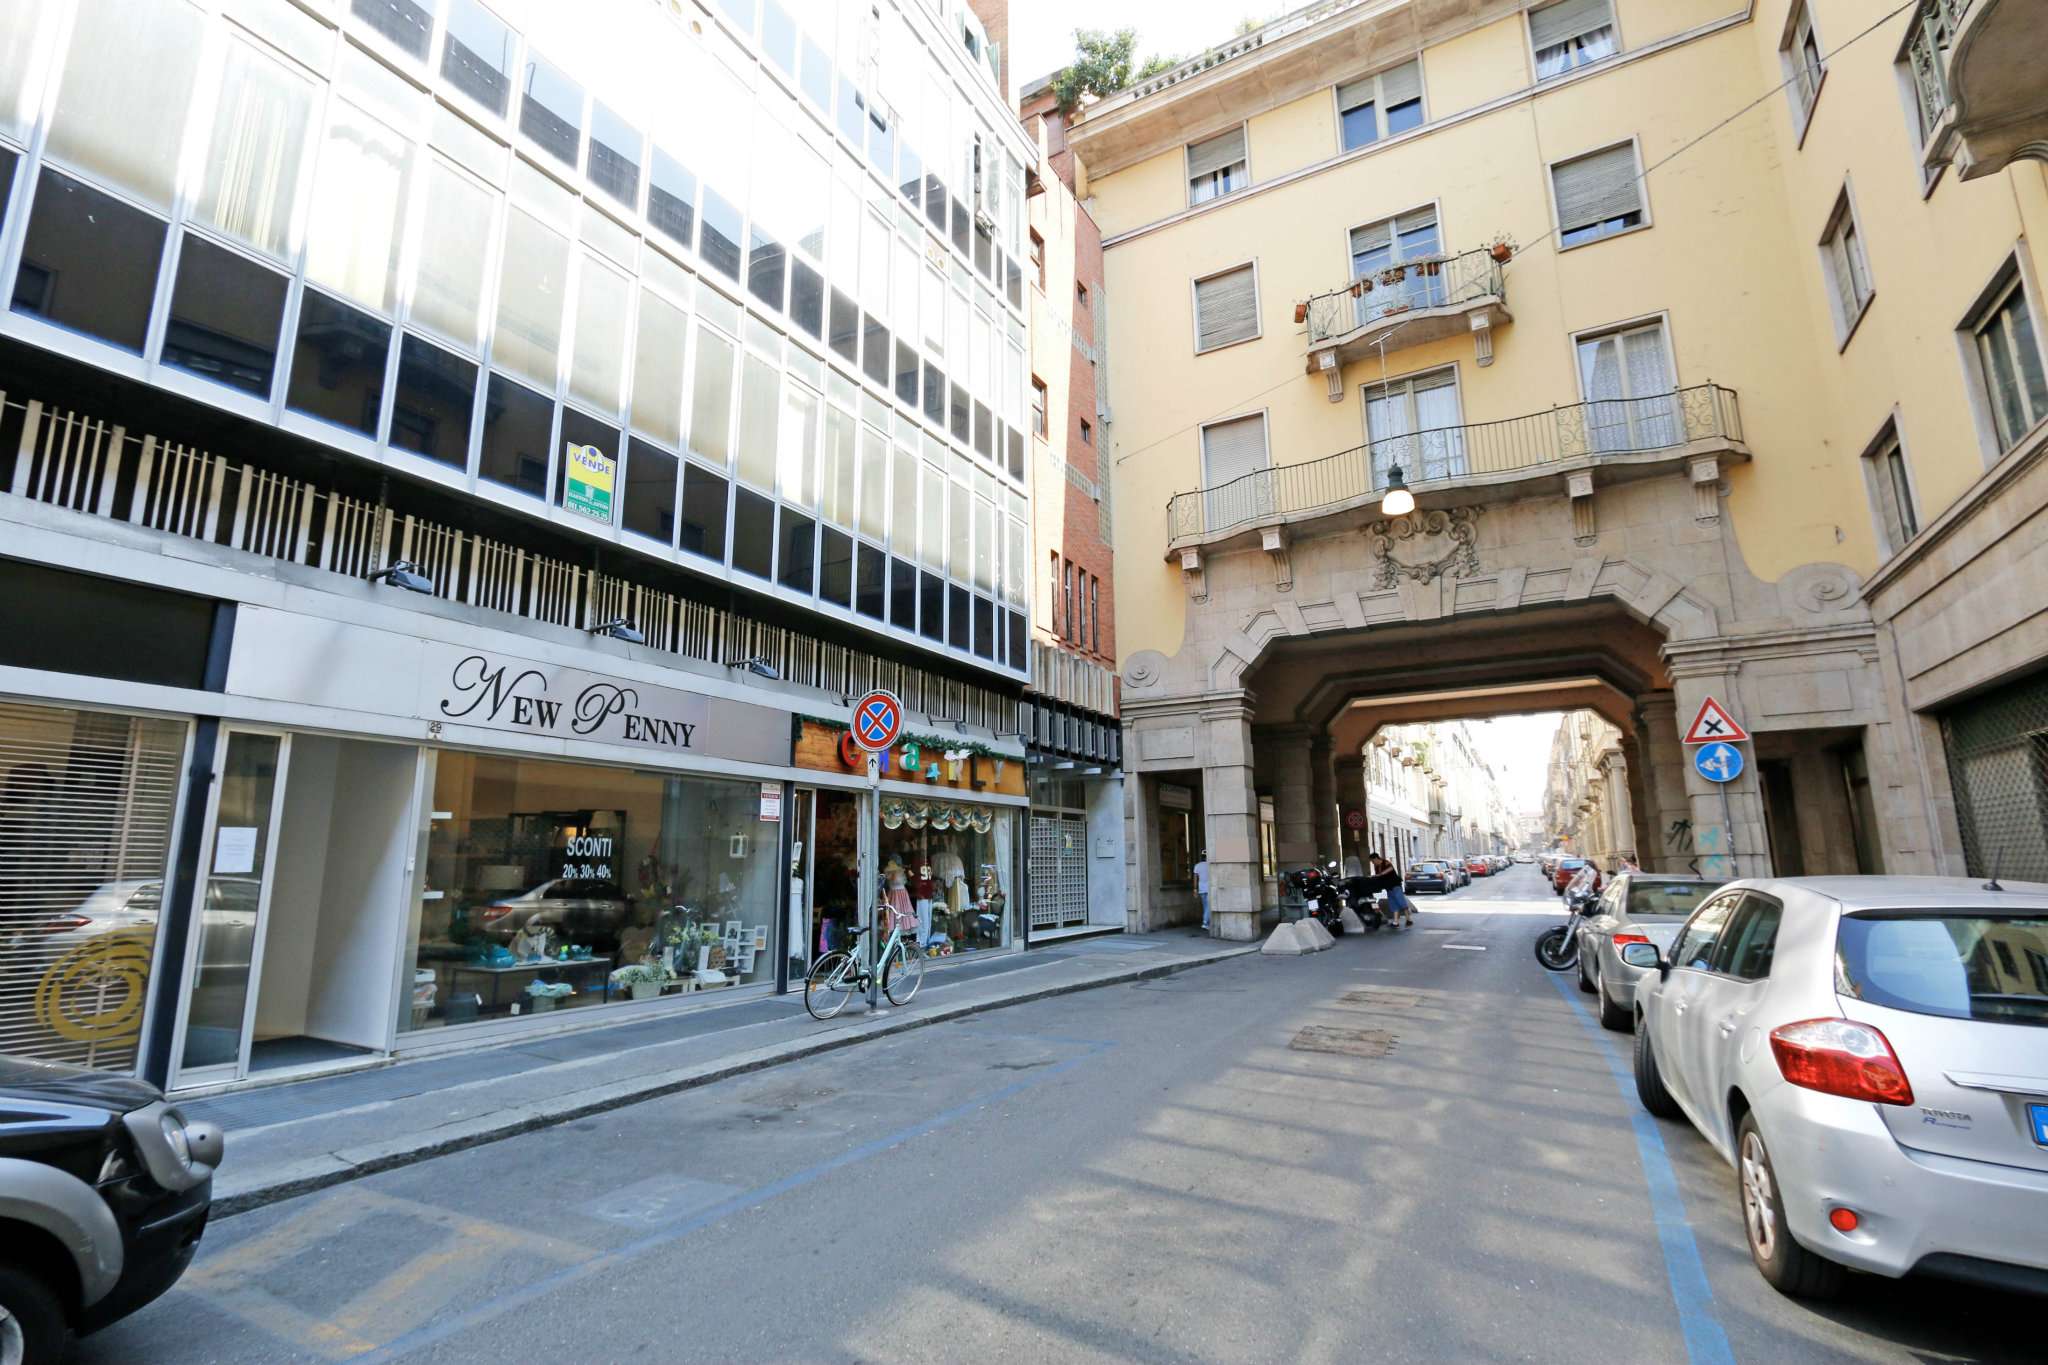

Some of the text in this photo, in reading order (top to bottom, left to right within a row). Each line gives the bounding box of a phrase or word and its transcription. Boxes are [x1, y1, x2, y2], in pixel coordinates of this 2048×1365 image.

[574, 452, 610, 474] VENDE
[440, 655, 697, 748] NEW PENNY
[566, 836, 612, 857] SCONTI
[562, 863, 612, 879] 20% 30% 40%
